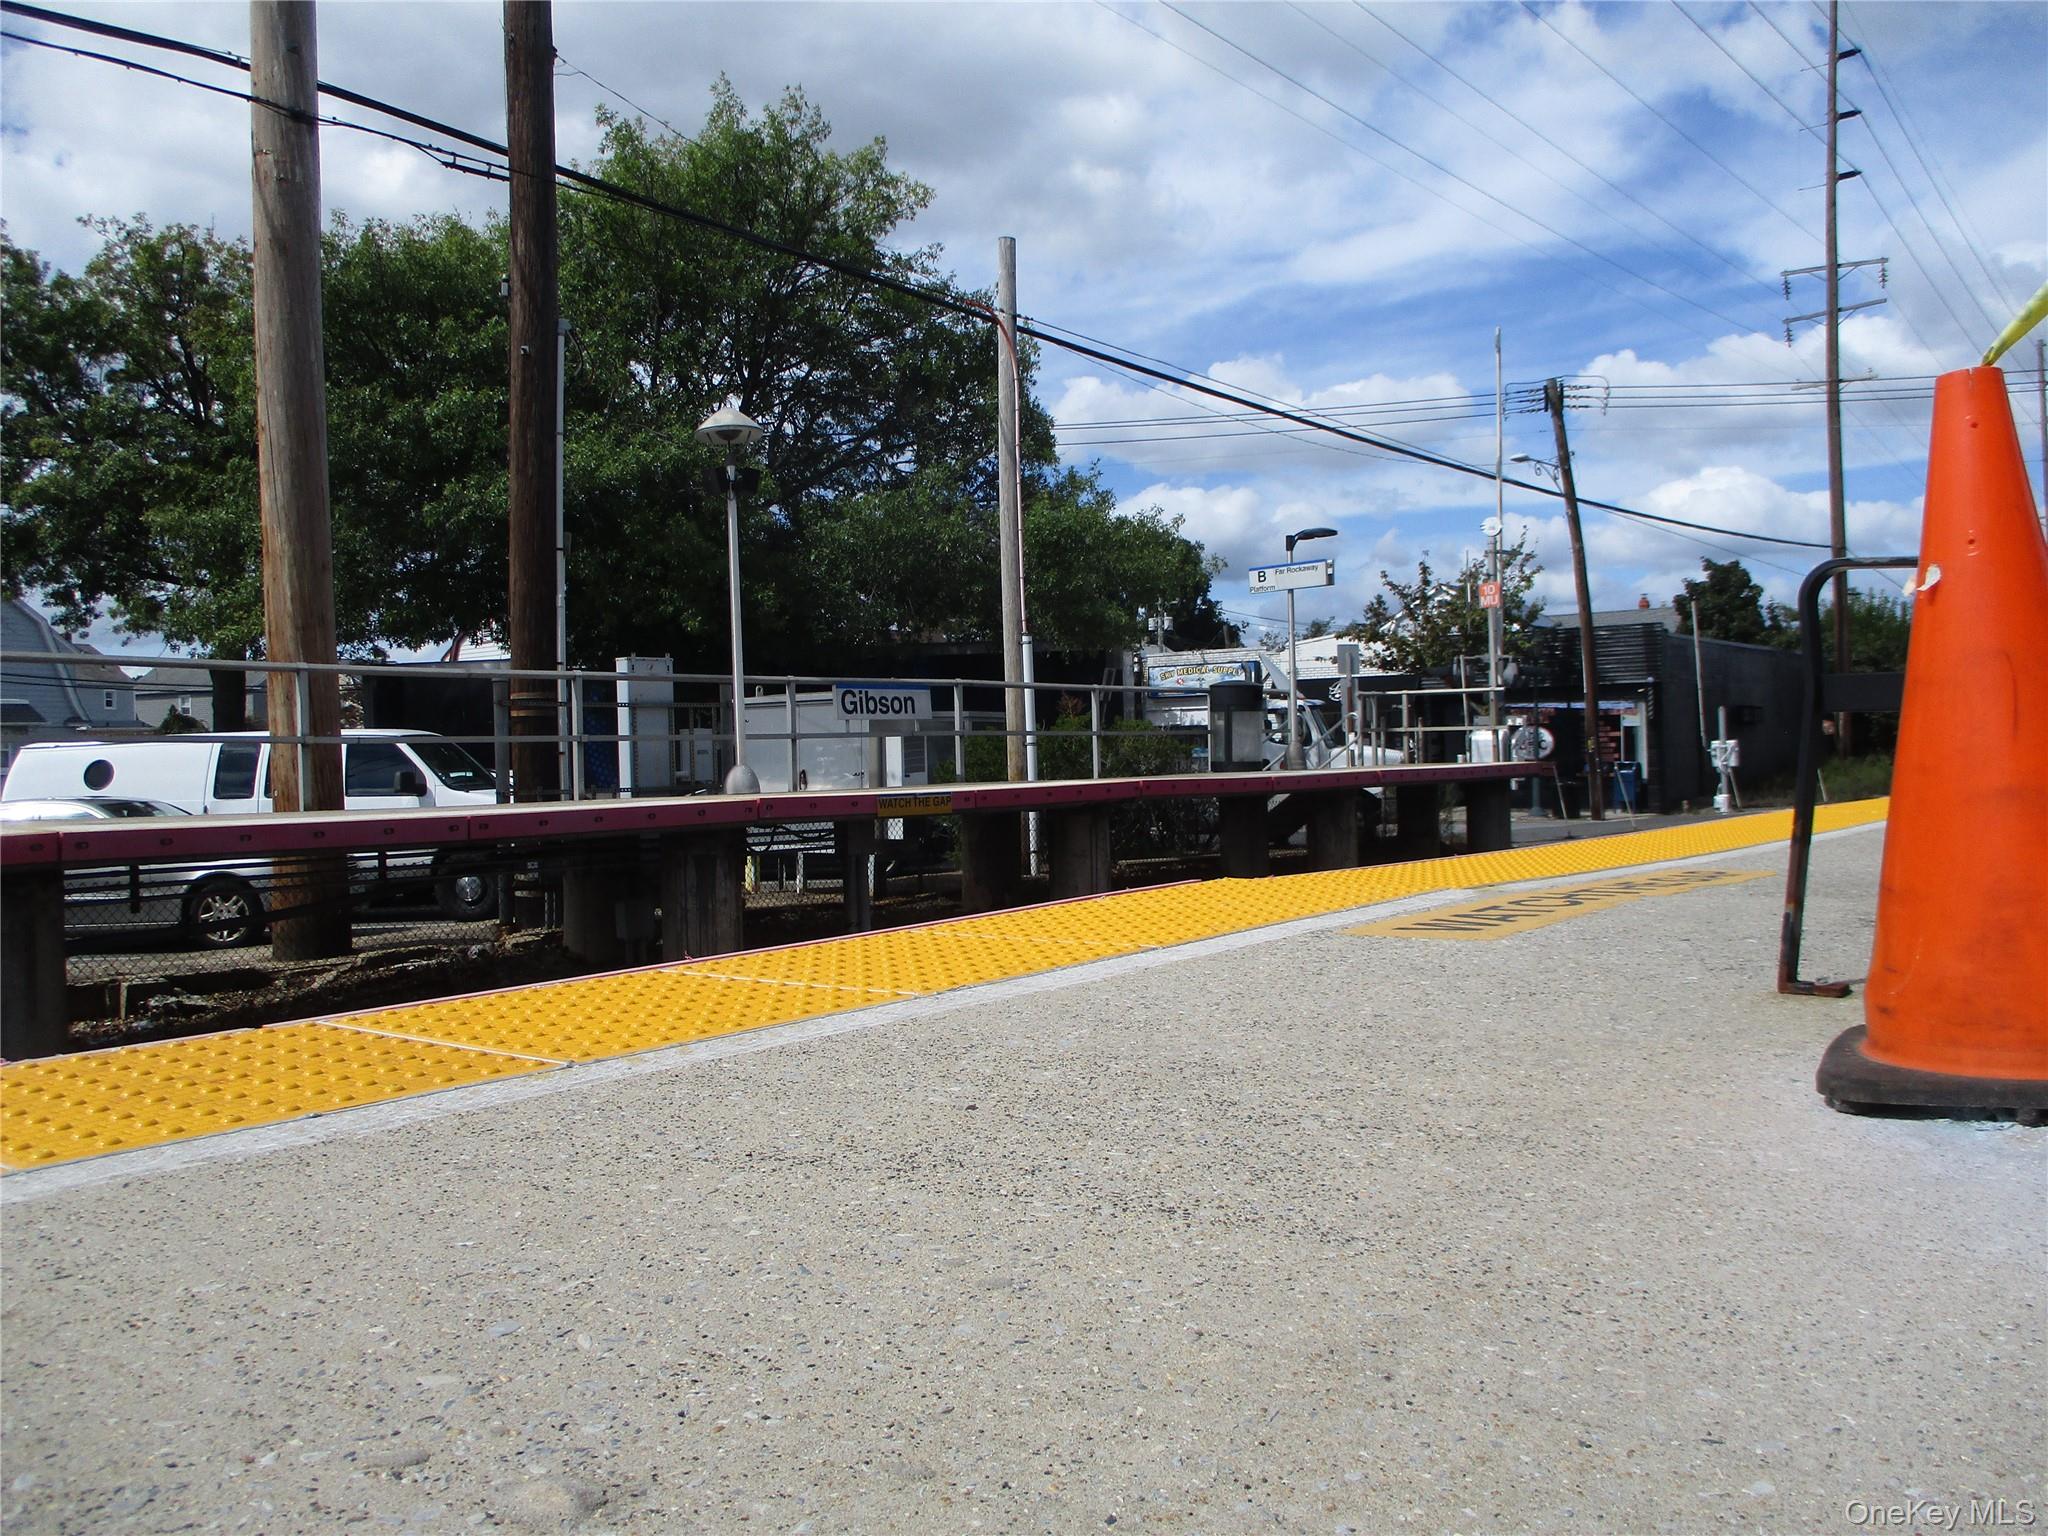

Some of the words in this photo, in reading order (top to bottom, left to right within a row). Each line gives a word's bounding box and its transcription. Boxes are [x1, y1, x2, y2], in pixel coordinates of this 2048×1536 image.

[1287, 564, 1318, 574] Rockaway
[1257, 570, 1267, 583] B
[1250, 584, 1276, 593] Platform
[1481, 584, 1496, 595] 10
[1481, 595, 1499, 606] MU
[1177, 665, 1210, 676] MEDICAL
[1212, 665, 1244, 676] SUPPLY
[841, 689, 916, 715] Gibson
[878, 797, 911, 809] WATCH
[914, 796, 930, 807] THE
[932, 795, 952, 807] GAP
[1391, 891, 1617, 931] WATCH
